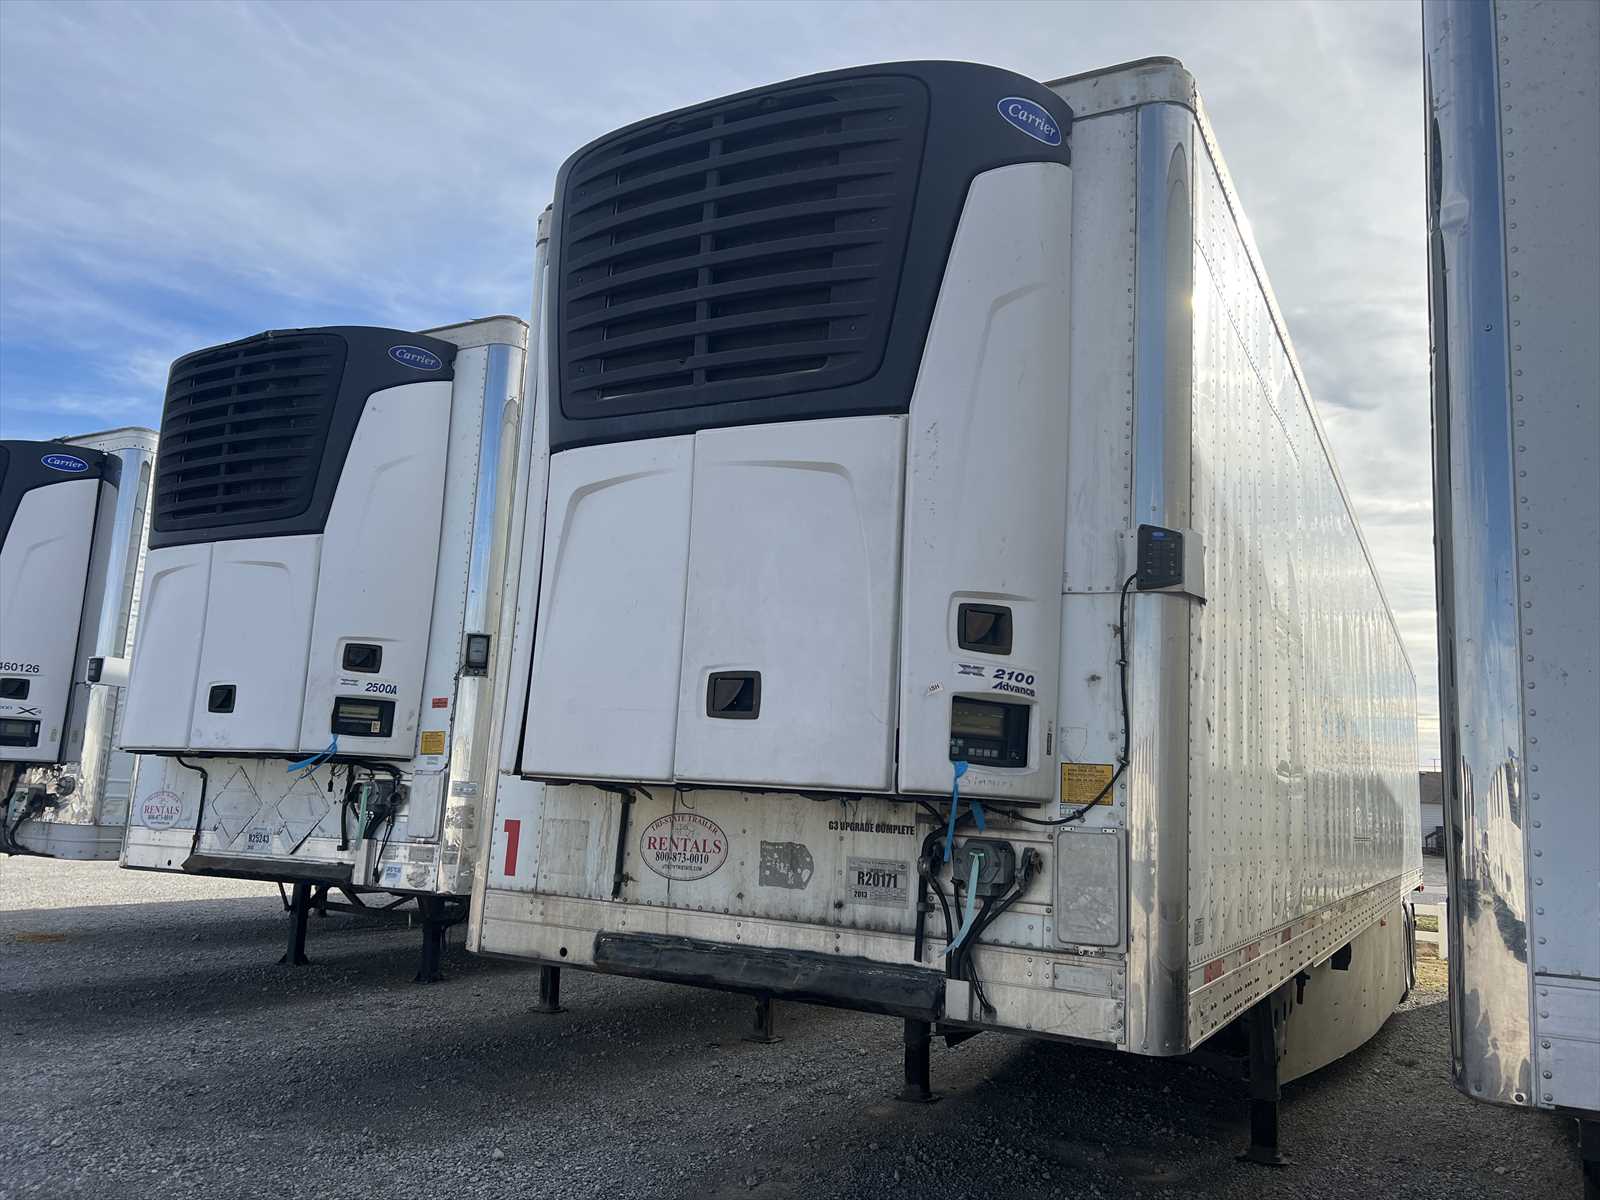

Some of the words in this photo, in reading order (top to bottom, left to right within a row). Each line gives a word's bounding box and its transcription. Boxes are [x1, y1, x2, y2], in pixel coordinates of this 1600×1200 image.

[1008, 103, 1056, 137] Carrier
[395, 349, 437, 366] Carrier
[47, 456, 84, 468] Carrier
[992, 668, 1035, 686] 2100
[364, 682, 398, 695] 2500A
[992, 680, 1035, 697] Advance
[143, 804, 180, 816] RENTALS
[651, 815, 687, 832] TRI-STATE
[688, 815, 719, 836] TRAILER
[840, 821, 875, 833] UPGRADE
[875, 823, 916, 836] COMPLETE
[504, 818, 521, 877] 1
[647, 836, 722, 855] RENTALS
[655, 851, 709, 865] 800-873-0010
[857, 870, 898, 889] R20171
